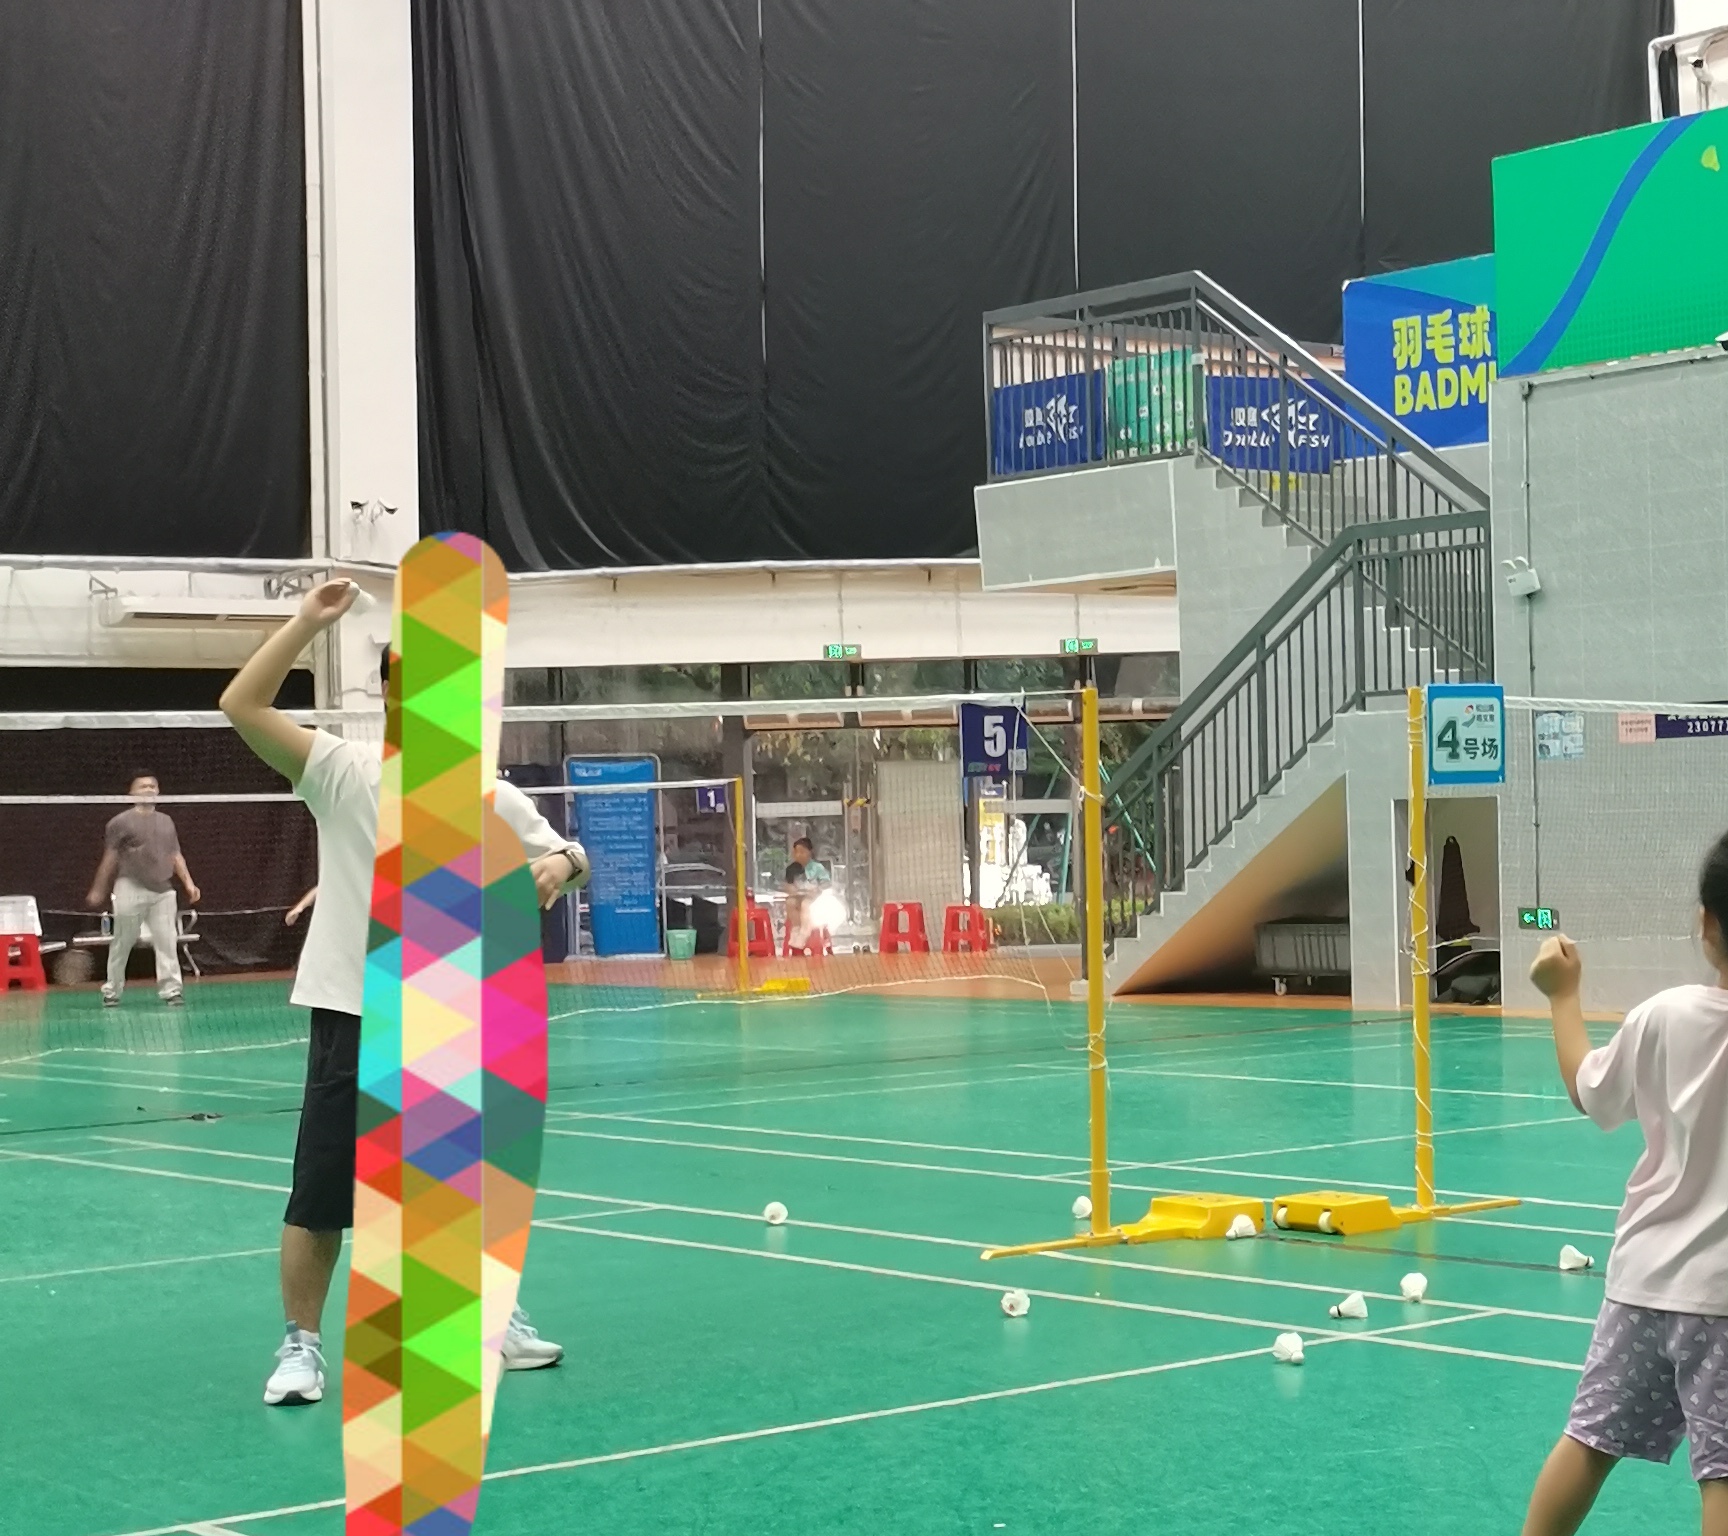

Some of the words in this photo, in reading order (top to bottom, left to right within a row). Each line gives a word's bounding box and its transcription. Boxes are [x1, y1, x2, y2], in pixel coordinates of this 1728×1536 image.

[1392, 304, 1491, 371] 羽毛球
[983, 715, 1007, 758] 5
[1436, 717, 1499, 761] 4号场
